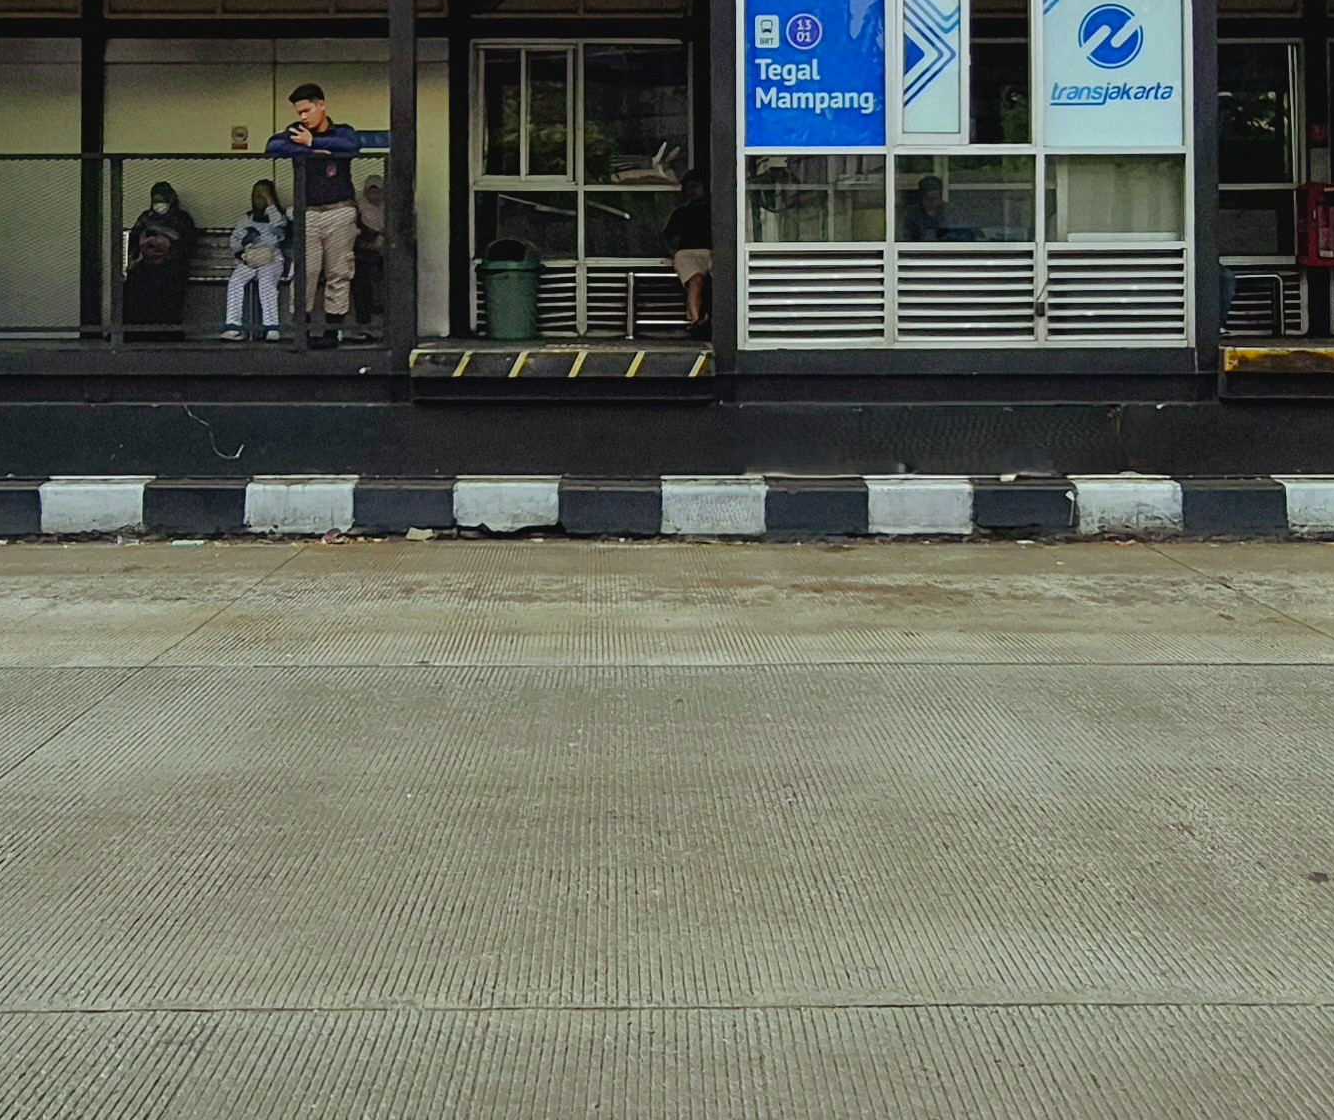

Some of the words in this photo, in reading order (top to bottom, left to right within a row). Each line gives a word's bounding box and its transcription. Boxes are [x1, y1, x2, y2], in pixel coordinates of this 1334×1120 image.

[796, 19, 812, 30] 13
[796, 31, 812, 42] 01
[754, 58, 820, 86] Tegal
[755, 86, 874, 114] Mampang
[1050, 82, 1173, 106] transjakarta
